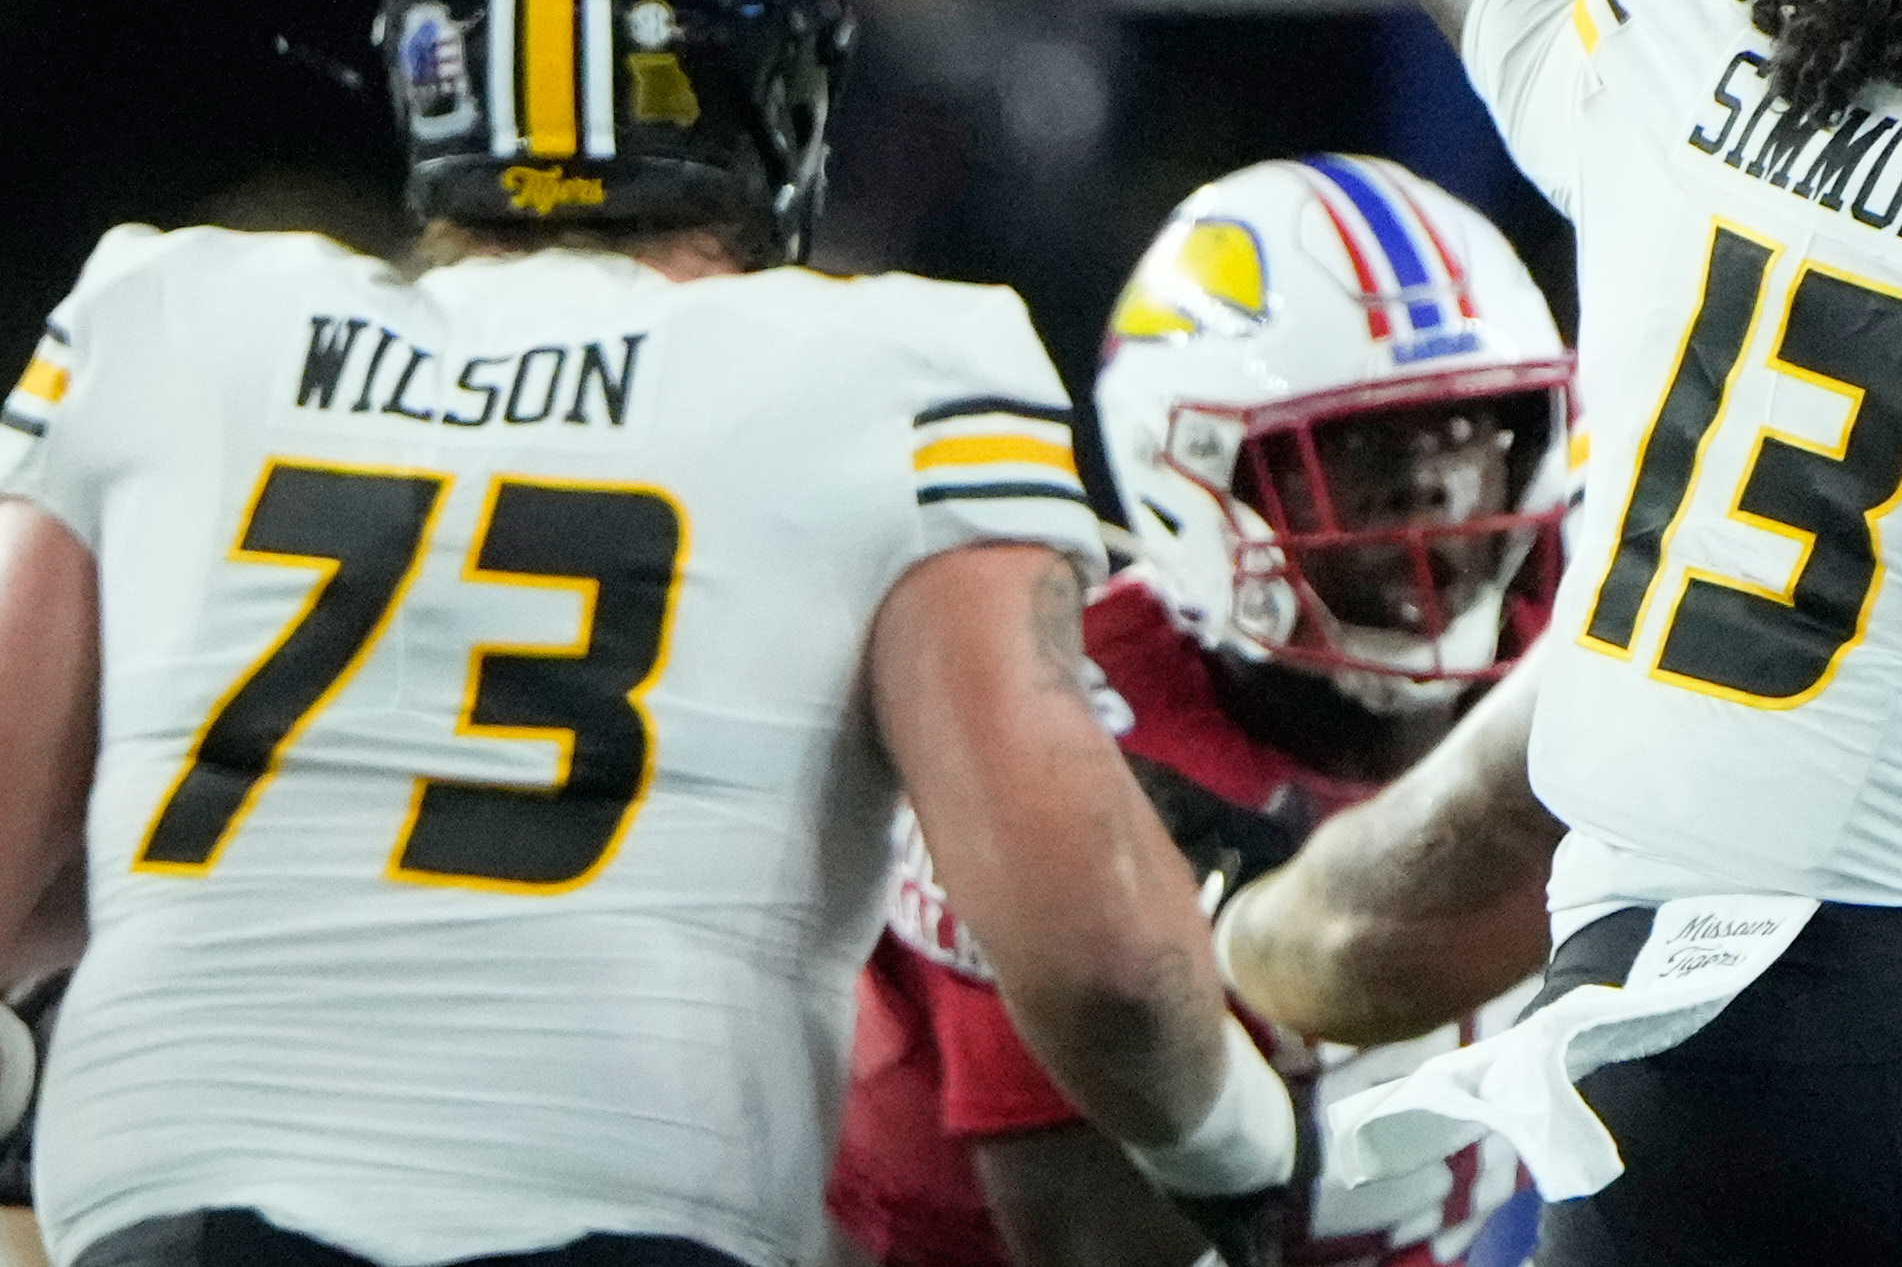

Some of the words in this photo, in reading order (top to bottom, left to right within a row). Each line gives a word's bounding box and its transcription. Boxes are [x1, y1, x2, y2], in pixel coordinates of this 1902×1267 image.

[295, 314, 650, 428] WILSON
[130, 454, 691, 896] 73
[1659, 944, 1748, 979] Tigers
[1666, 913, 1786, 944] Missouri
